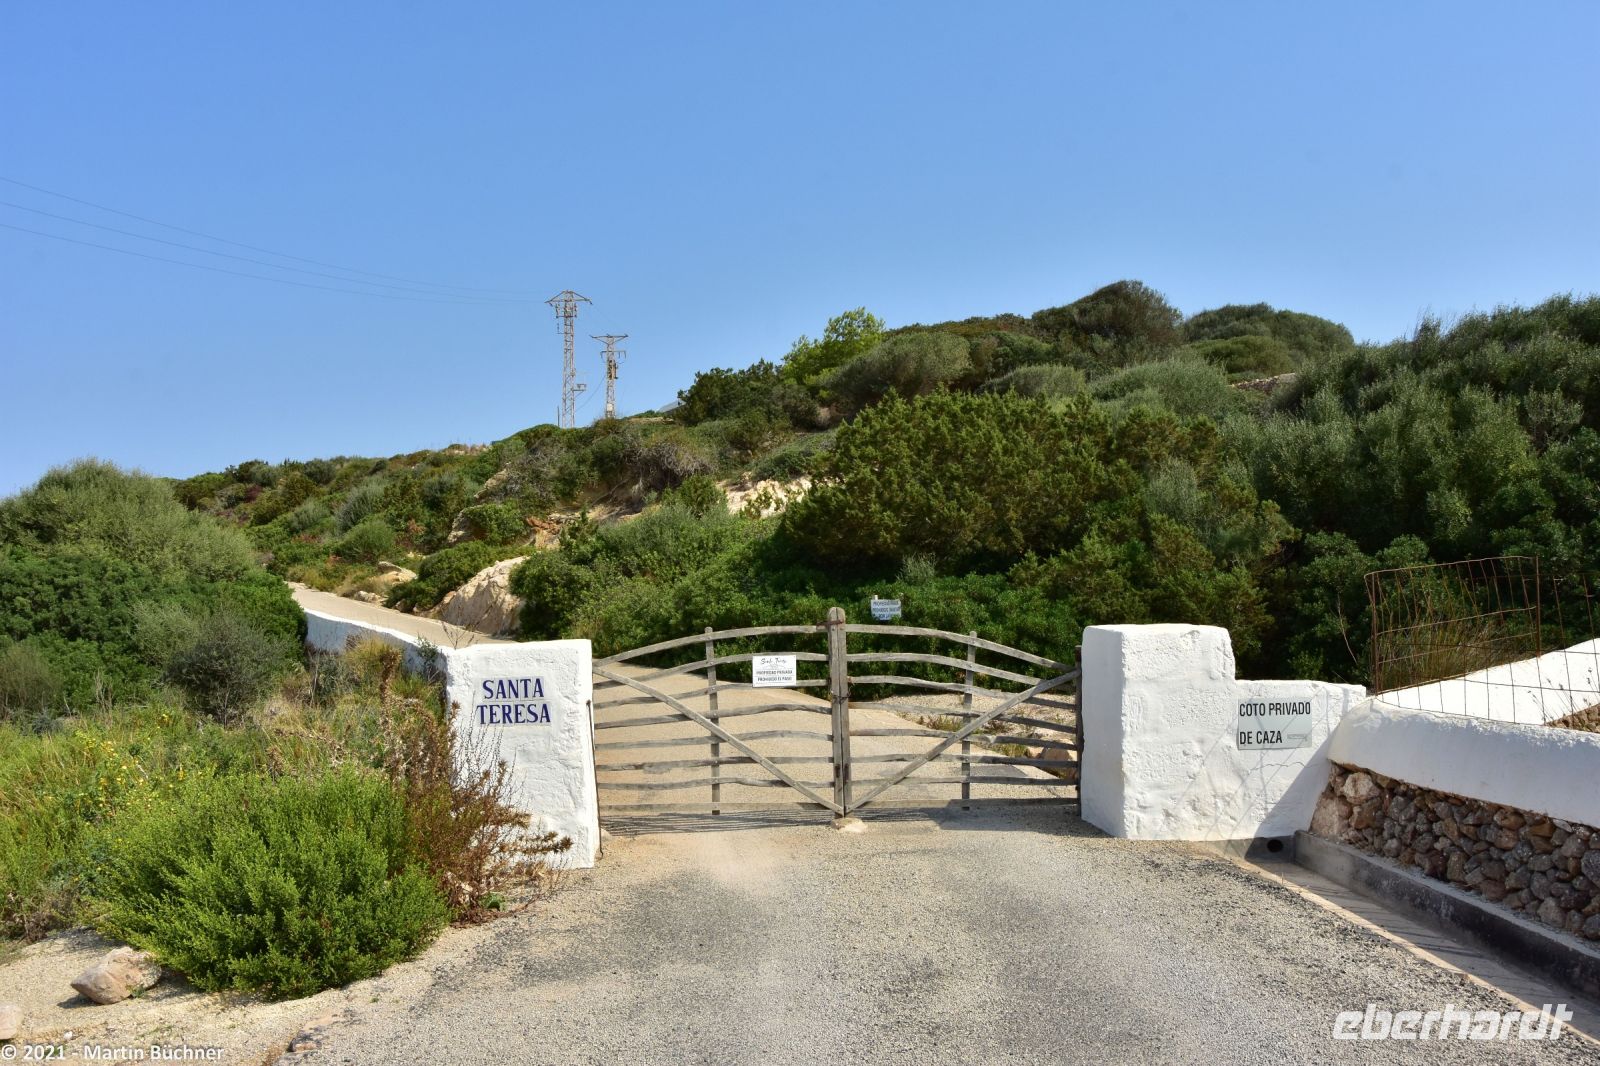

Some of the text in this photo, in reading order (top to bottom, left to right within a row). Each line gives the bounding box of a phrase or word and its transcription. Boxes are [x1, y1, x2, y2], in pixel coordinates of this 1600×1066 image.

[482, 678, 544, 699] SANTA
[476, 703, 551, 724] TERESA
[1239, 702, 1311, 717] COTO PRIVADO
[1239, 731, 1253, 745] DE
[1256, 730, 1283, 745] CAZA
